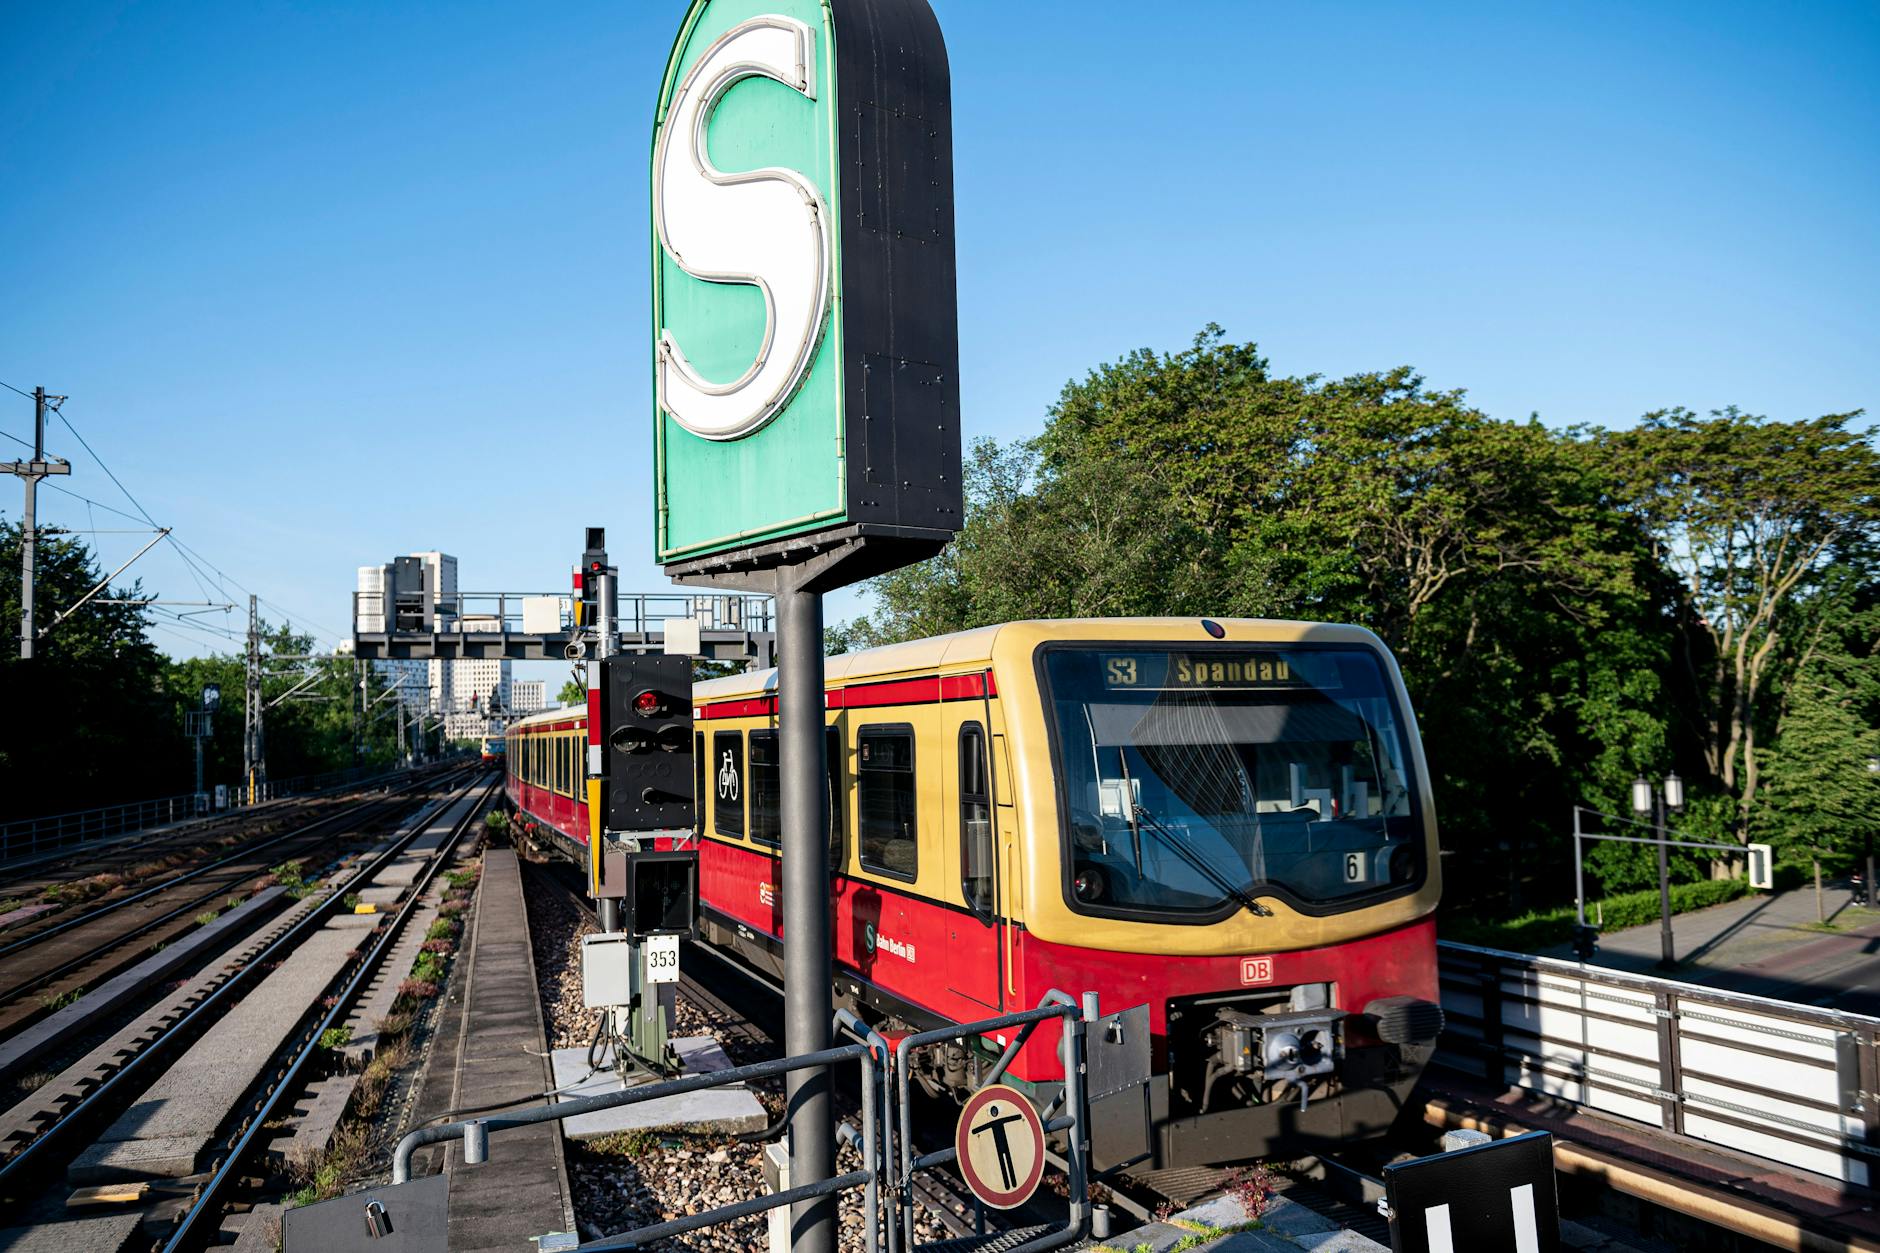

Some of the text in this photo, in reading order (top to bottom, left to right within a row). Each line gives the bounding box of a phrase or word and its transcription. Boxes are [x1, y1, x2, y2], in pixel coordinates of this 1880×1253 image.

[655, 14, 831, 441] S
[1107, 658, 1289, 684] S3 Spandau
[1346, 854, 1358, 880] 6
[650, 950, 676, 968] 353
[1244, 961, 1270, 981] DB
